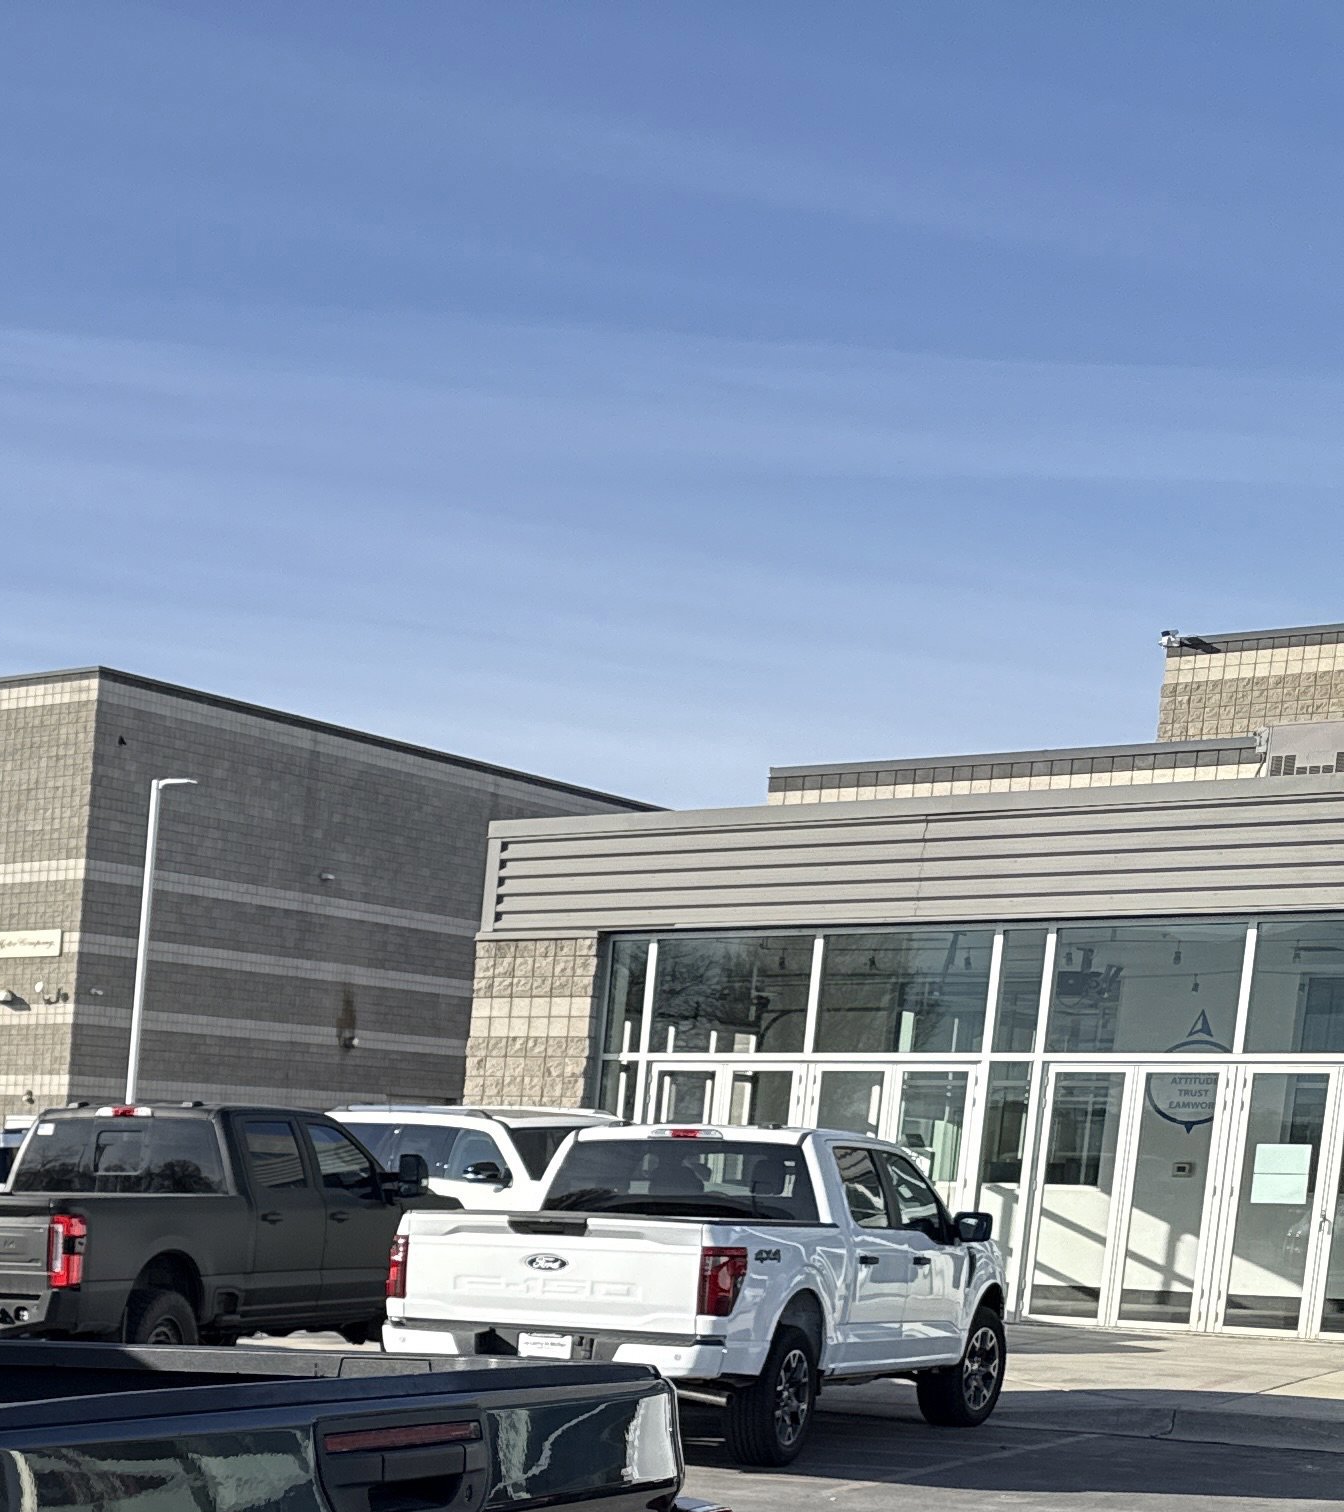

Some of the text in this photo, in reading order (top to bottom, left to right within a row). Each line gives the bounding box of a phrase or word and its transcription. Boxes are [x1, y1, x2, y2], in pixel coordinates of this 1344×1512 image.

[1177, 1088, 1209, 1097] TRUST
[531, 1255, 562, 1271] Ford
[453, 1273, 641, 1298] F-150
